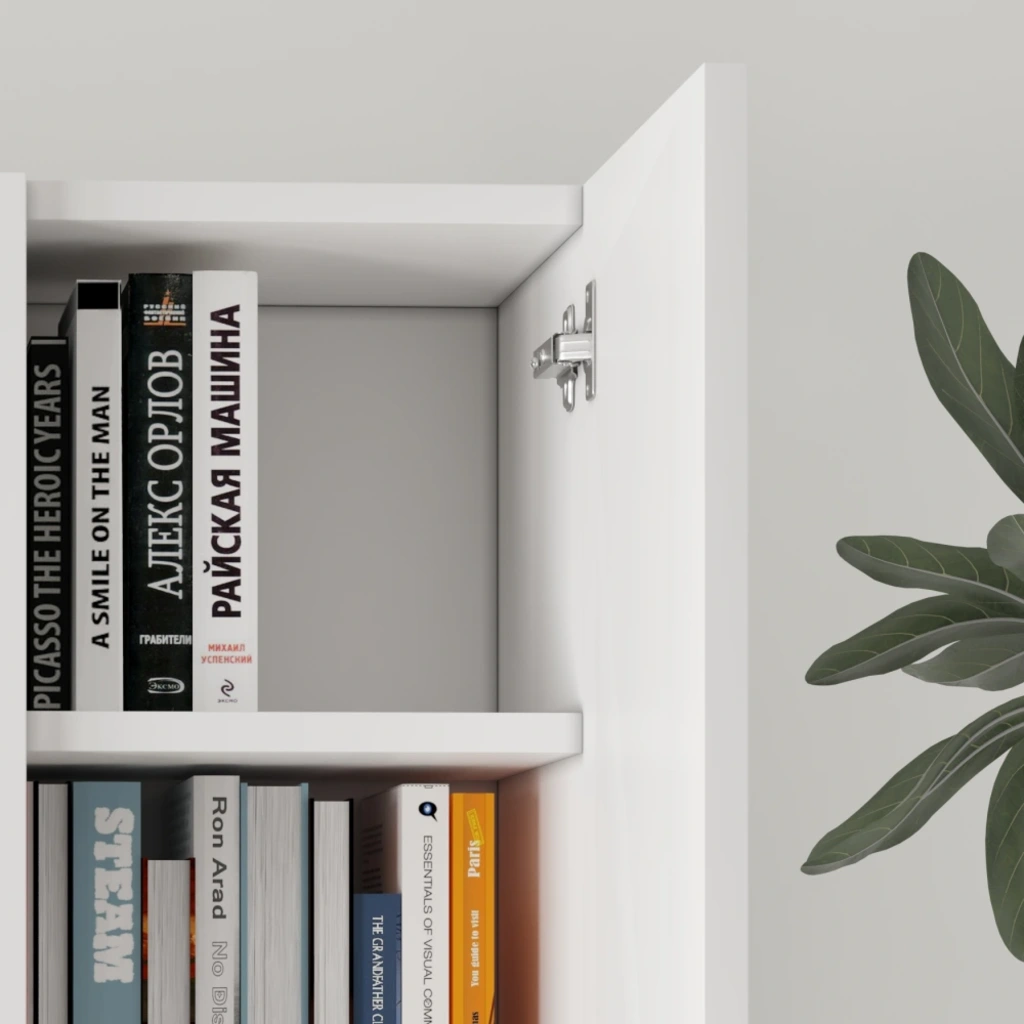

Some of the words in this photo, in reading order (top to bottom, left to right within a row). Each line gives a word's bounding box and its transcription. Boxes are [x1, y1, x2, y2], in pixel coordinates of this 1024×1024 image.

[34, 364, 61, 442] YEARS
[210, 305, 240, 456] МАШИНА
[92, 387, 109, 444] MAN
[147, 350, 183, 470] ОРЛОВ
[34, 449, 61, 542] HEROIC
[92, 452, 109, 500] THE
[92, 508, 109, 542] ON
[147, 480, 183, 599] АЛЕКС
[203, 470, 241, 617] РАЙСКАЯ
[34, 550, 61, 598] THE
[92, 550, 109, 625] SMILE
[33, 604, 61, 709] PICASSO
[92, 633, 109, 648] A
[139, 634, 192, 645] ГРАБИТЕЛИ
[201, 654, 252, 664] УСПЕНСКИЙ
[208, 643, 245, 652] МИХАИЛ
[212, 797, 227, 847] Ron
[424, 835, 432, 914] ESSENTIALS
[468, 840, 481, 877] Paris
[93, 807, 134, 983] STEAM
[212, 858, 227, 919] Arad
[372, 916, 383, 935] THE
[424, 918, 432, 935] OF
[471, 910, 479, 928] visit
[471, 930, 479, 939] to
[211, 940, 229, 978] No
[372, 938, 383, 1010] GRANDFATHER
[424, 939, 432, 985] VISUAL
[471, 941, 480, 967] guide
[471, 970, 479, 986] You
